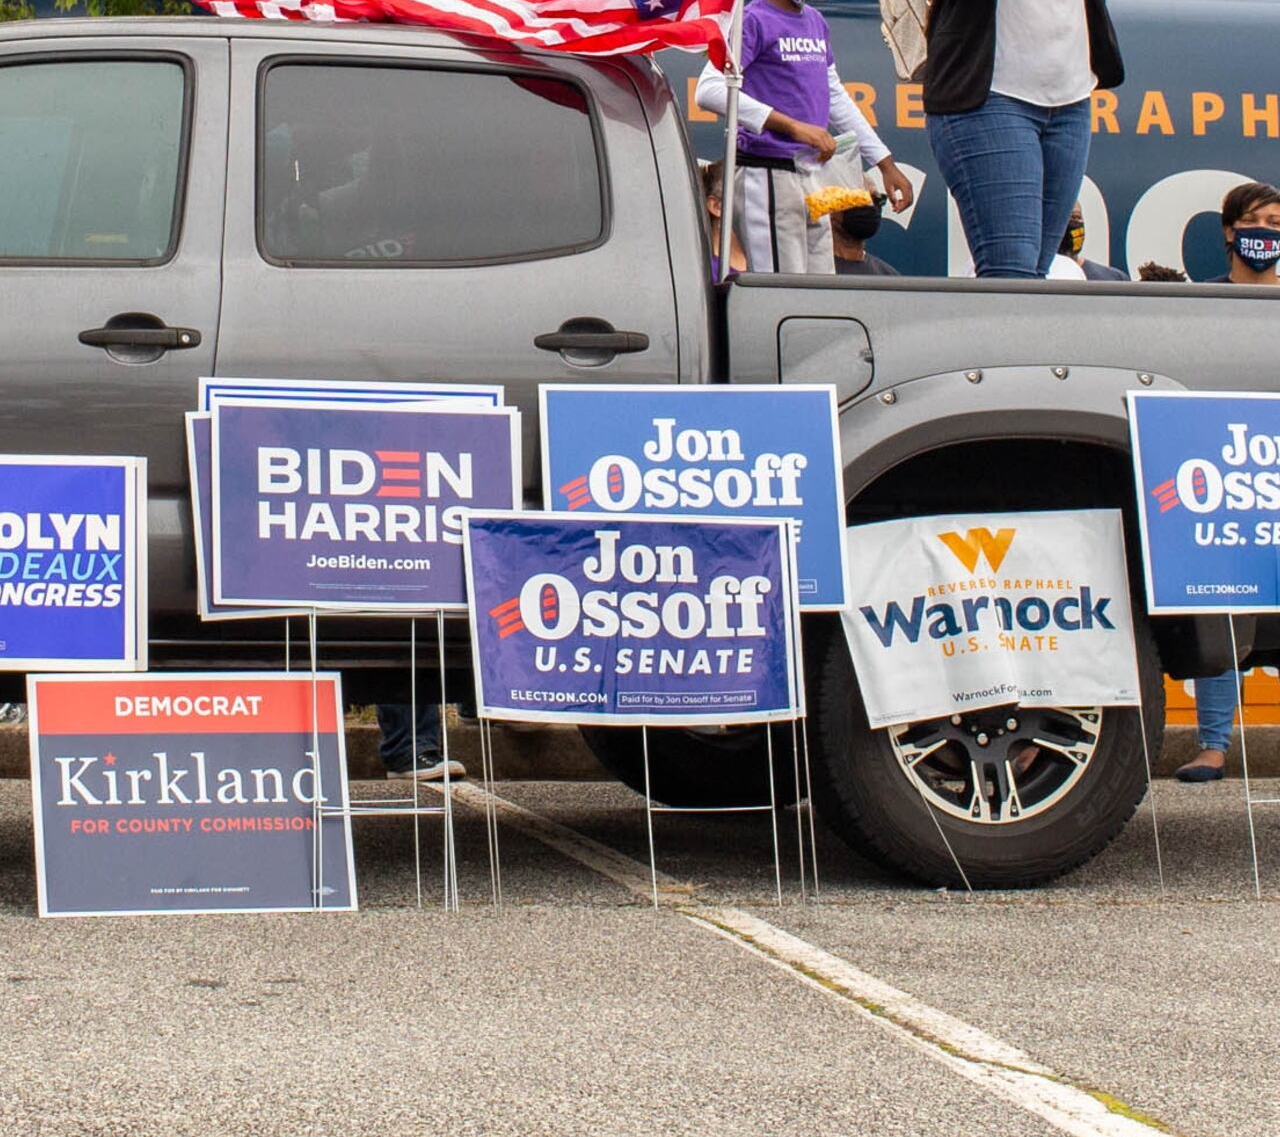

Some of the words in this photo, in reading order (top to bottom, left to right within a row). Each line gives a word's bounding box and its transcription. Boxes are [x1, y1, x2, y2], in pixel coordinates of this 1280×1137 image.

[1240, 238, 1280, 251] BIDEN
[643, 418, 744, 463] Jon
[258, 446, 473, 499] BIDEN
[589, 453, 807, 512] Ossoff
[258, 501, 464, 545] HARRIS
[1195, 522, 1247, 546] U.S.
[306, 554, 431, 571] JoeBiden.com
[583, 530, 698, 584] Jon
[1003, 579, 1073, 591] RAPHAEL
[1186, 584, 1259, 594] ELECTJON.COM
[520, 573, 772, 640] Ossoff
[859, 586, 1116, 648] Warnock
[942, 636, 988, 658] U.S.
[535, 646, 602, 673] U.S.
[615, 647, 754, 675] SENATE
[115, 695, 262, 717] DEMOCRAT
[511, 689, 608, 704] ELECTJON.COM
[622, 695, 640, 704] Paid
[641, 694, 653, 704] for
[654, 695, 665, 705] by
[665, 695, 681, 704] Jon
[682, 694, 709, 704] Ossoff
[710, 694, 722, 703] for
[723, 693, 753, 703] Senate
[54, 751, 329, 806] Kirkland
[71, 819, 110, 834] FOR
[116, 818, 194, 833] COUNTY
